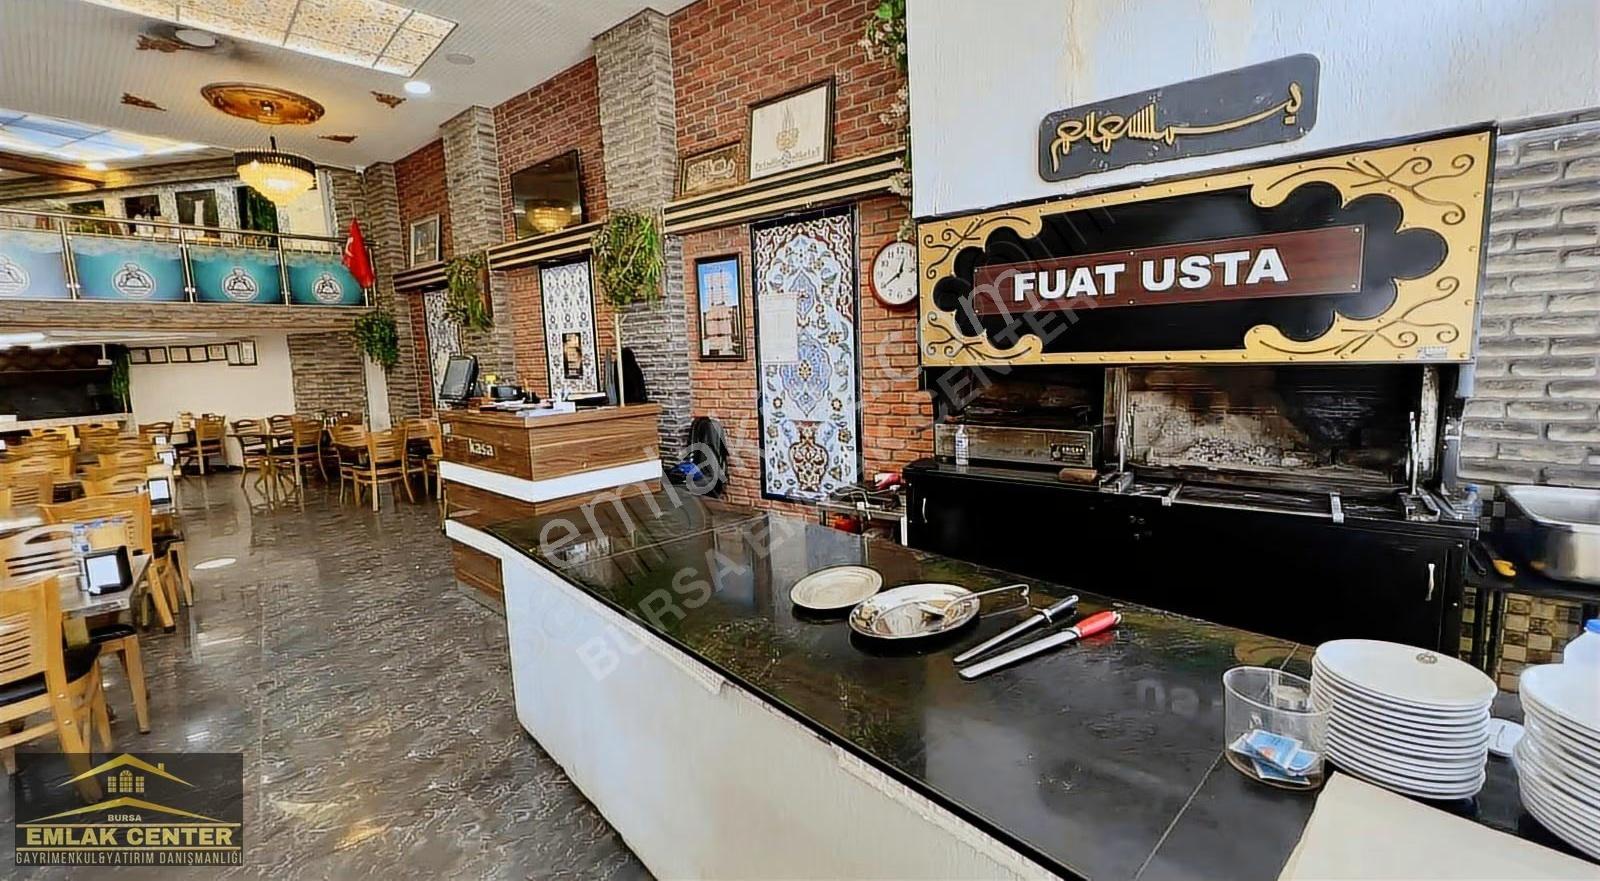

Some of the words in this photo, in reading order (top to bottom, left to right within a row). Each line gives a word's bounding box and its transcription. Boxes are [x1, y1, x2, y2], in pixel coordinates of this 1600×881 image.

[1014, 263, 1126, 301] FUAT
[1141, 248, 1288, 291] USTA
[468, 438, 495, 457] kasa
